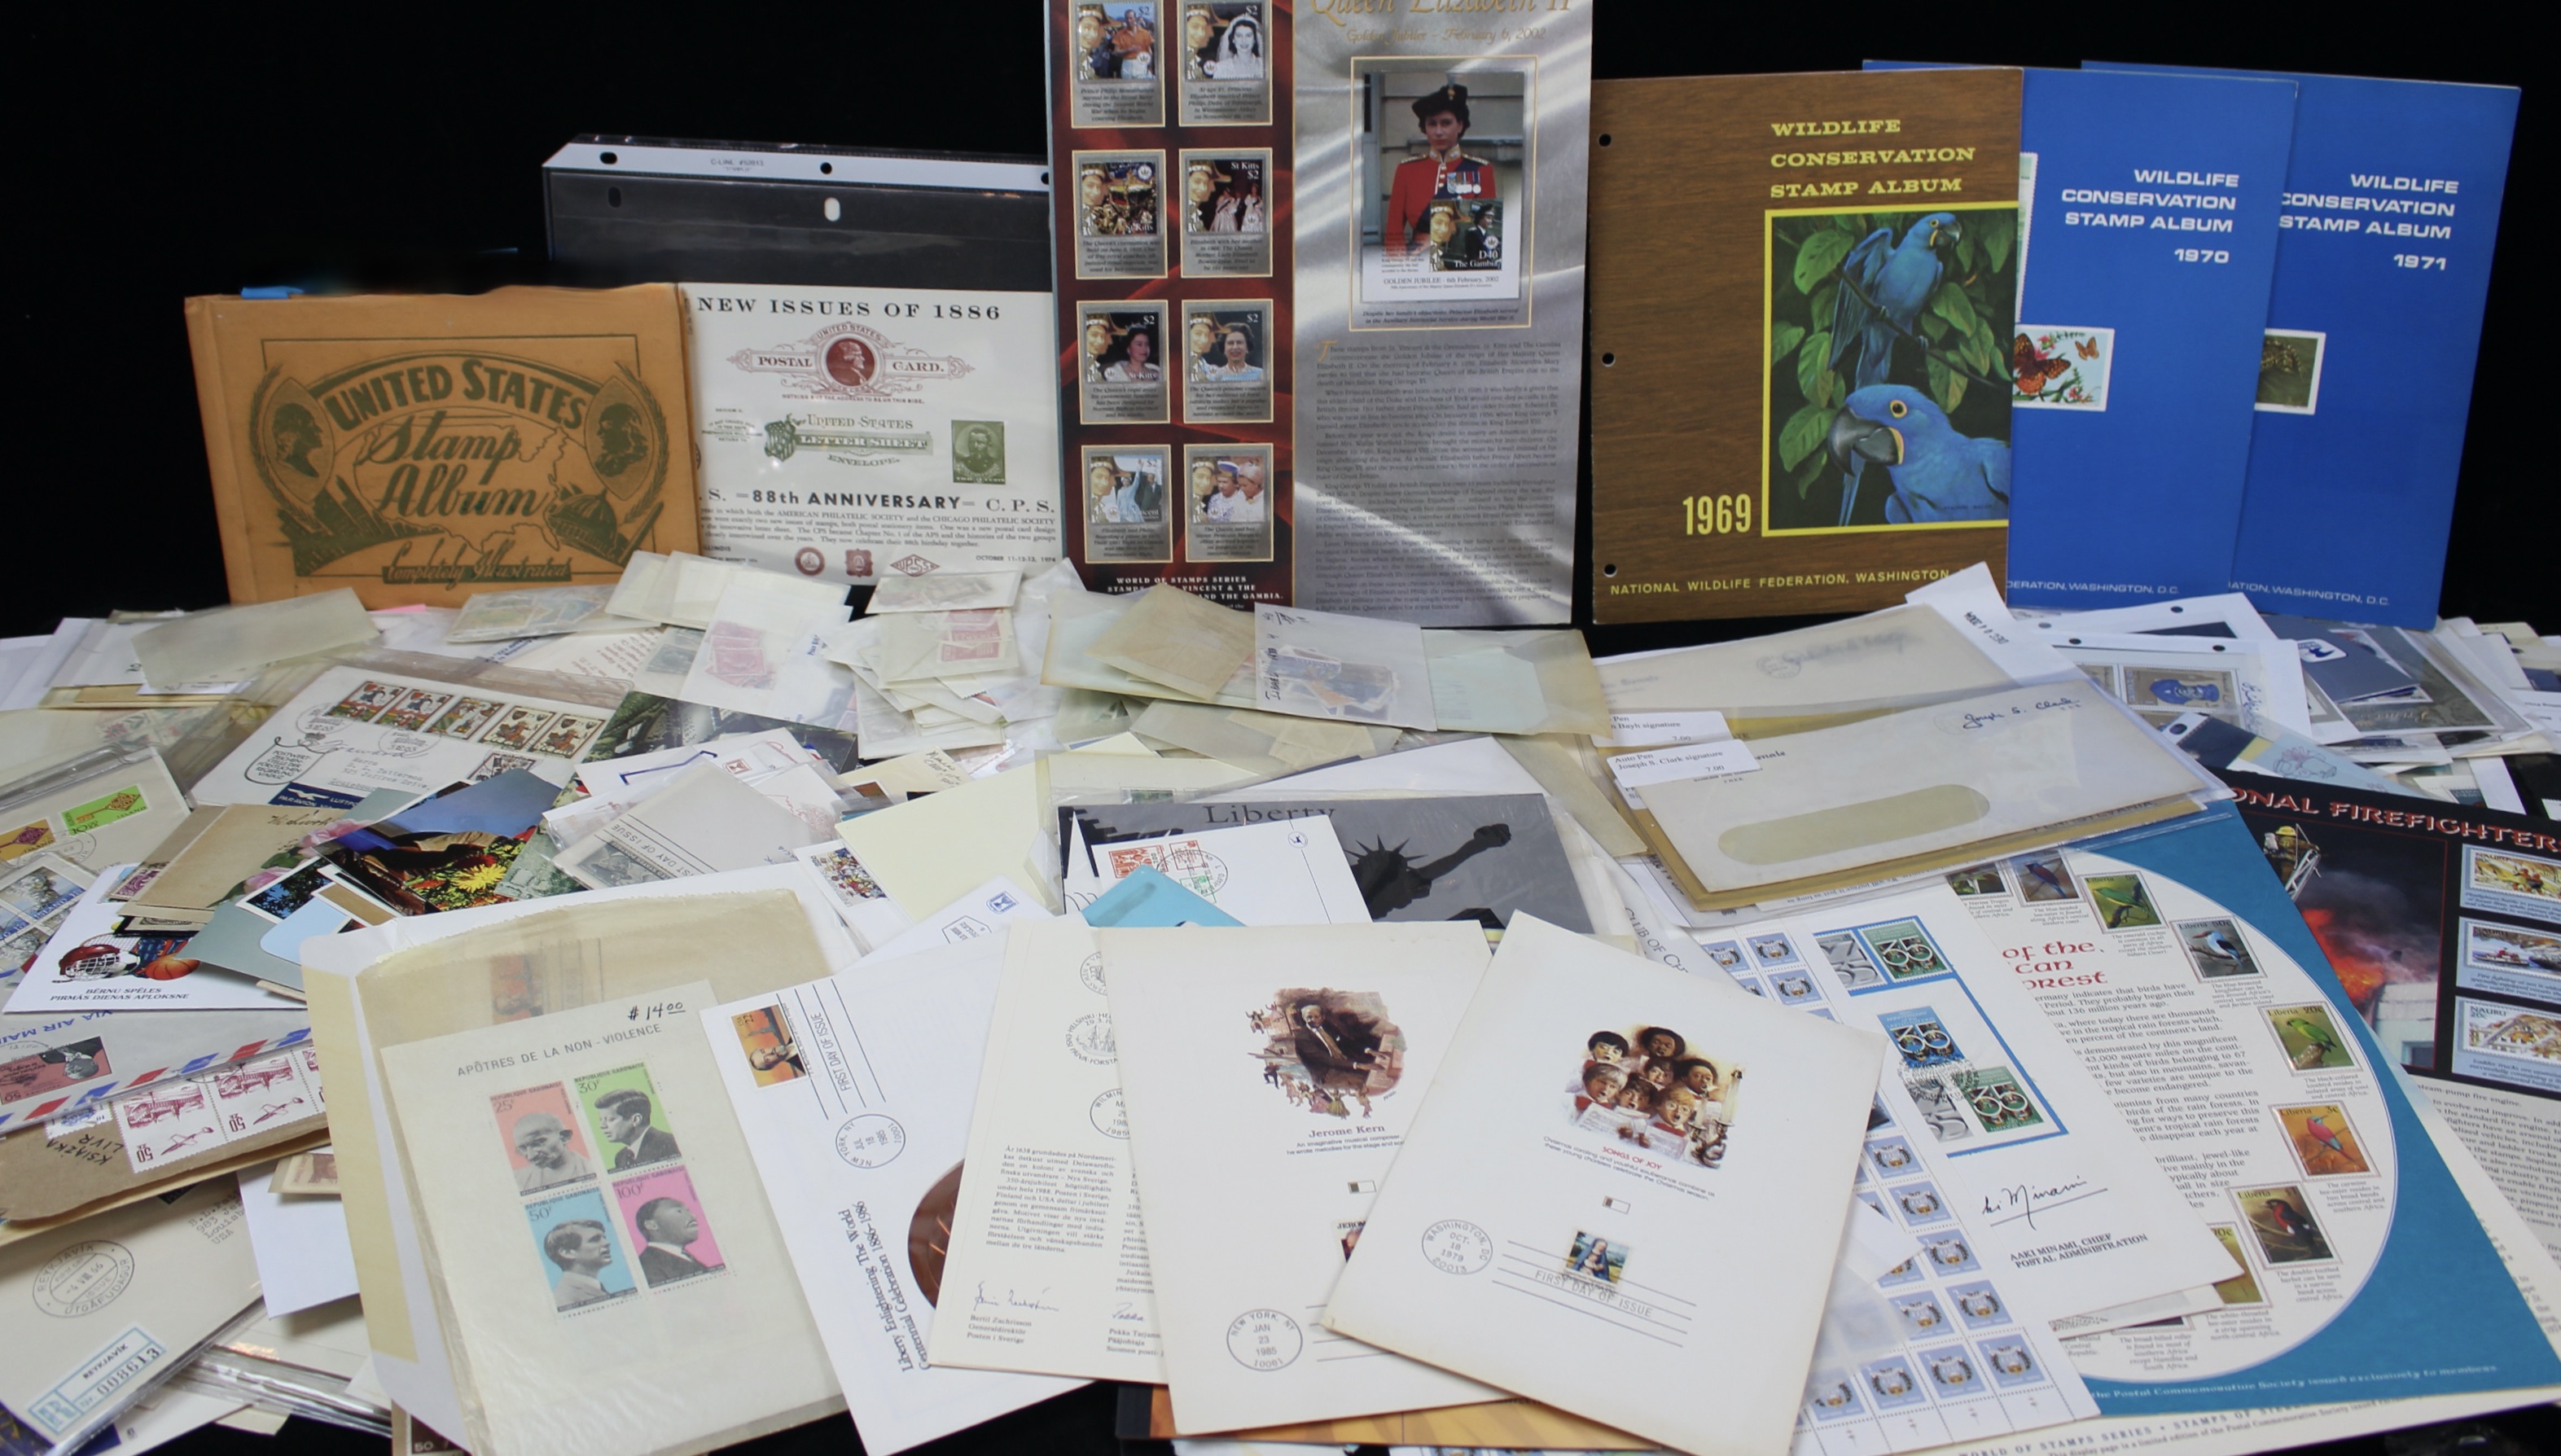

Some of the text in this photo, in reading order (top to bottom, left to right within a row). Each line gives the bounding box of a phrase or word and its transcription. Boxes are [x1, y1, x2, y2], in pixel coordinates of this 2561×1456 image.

[1347, 29, 1384, 43] Golden
[1515, 28, 1547, 40] 2002
[1771, 118, 1901, 137] WILDLIFE
[1231, 161, 1260, 170] St Kitts
[1770, 147, 1976, 168] CONSERVATION
[1247, 170, 1259, 179] $2
[2133, 168, 2240, 188] WILDLIFE
[2349, 173, 2459, 195] WILDLIFE
[1770, 178, 1962, 199] STAMP ALBUM
[2061, 188, 2237, 211] CONSERVATION
[2064, 212, 2234, 233] STAMP ALBUM
[2278, 215, 2451, 240] STAMP ALBUM
[2173, 248, 2230, 265] 1970
[2392, 252, 2448, 272] 1971
[698, 296, 1001, 320] NEW ISSUES OF 1886
[1247, 313, 1259, 323] $2
[1142, 315, 1155, 325] $2
[816, 324, 883, 342] UNITED STATES
[757, 356, 945, 373] POSTAL CARD.
[327, 358, 587, 432] UNITED STATES
[357, 410, 522, 483] Stamp
[799, 435, 866, 448] LETTER
[375, 463, 556, 519] Album
[752, 489, 800, 504] 88th
[808, 493, 960, 510] ANNIVERSARY
[986, 498, 1006, 512] C.
[1011, 498, 1031, 512] P.
[1036, 499, 1055, 513] S.
[1682, 493, 1752, 536] 1969
[384, 536, 571, 590] Completely Illustrated
[1610, 581, 1680, 595] NATIONAL
[1687, 577, 1752, 592] WILDLIFE
[1855, 568, 1949, 585] WASHINGTON
[2068, 582, 2179, 594] WASHINGTON, D.C.
[2272, 585, 2390, 606] WASHINGTON, D.C.
[1618, 761, 1647, 770] Joseph
[1660, 757, 1683, 765] Clark
[1686, 751, 1723, 761] signature
[1204, 805, 1335, 822] Liberty
[611, 824, 642, 844] ISSUE
[2002, 941, 2094, 962] of the
[2470, 1006, 2506, 1016] NAURU
[2102, 1016, 2222, 1032] tropical rain forests which,
[458, 1024, 661, 1077] APÔTRES DE LA NON VIOLENCE
[810, 1012, 852, 1091] FIRST DAY OF ISSUE
[2279, 1107, 2312, 1116] Liberia
[844, 1122, 855, 1131] NY
[1309, 1125, 1385, 1138] Jerome Kern
[851, 1156, 871, 1166] NEW
[1602, 1147, 1629, 1160] SONGS
[1647, 1160, 1663, 1170] JOY
[211, 1228, 235, 1245] USA
[1441, 1248, 1465, 1263] 1979
[2011, 1233, 2112, 1261] AAKI MINAMI, CHIEF
[2015, 1234, 2148, 1269] POSTAL ADMINISTRATION
[838, 1208, 914, 1372] Liberty Enlightening The World
[1535, 1270, 1568, 1288] FIRST
[1619, 1298, 1654, 1318] ISSUE
[879, 1254, 932, 1370] Centennial Celebration
[1252, 1323, 1271, 1333] JAN
[1258, 1335, 1270, 1344] 23
[1256, 1347, 1278, 1357] 1985
[96, 1348, 160, 1396] 008613
